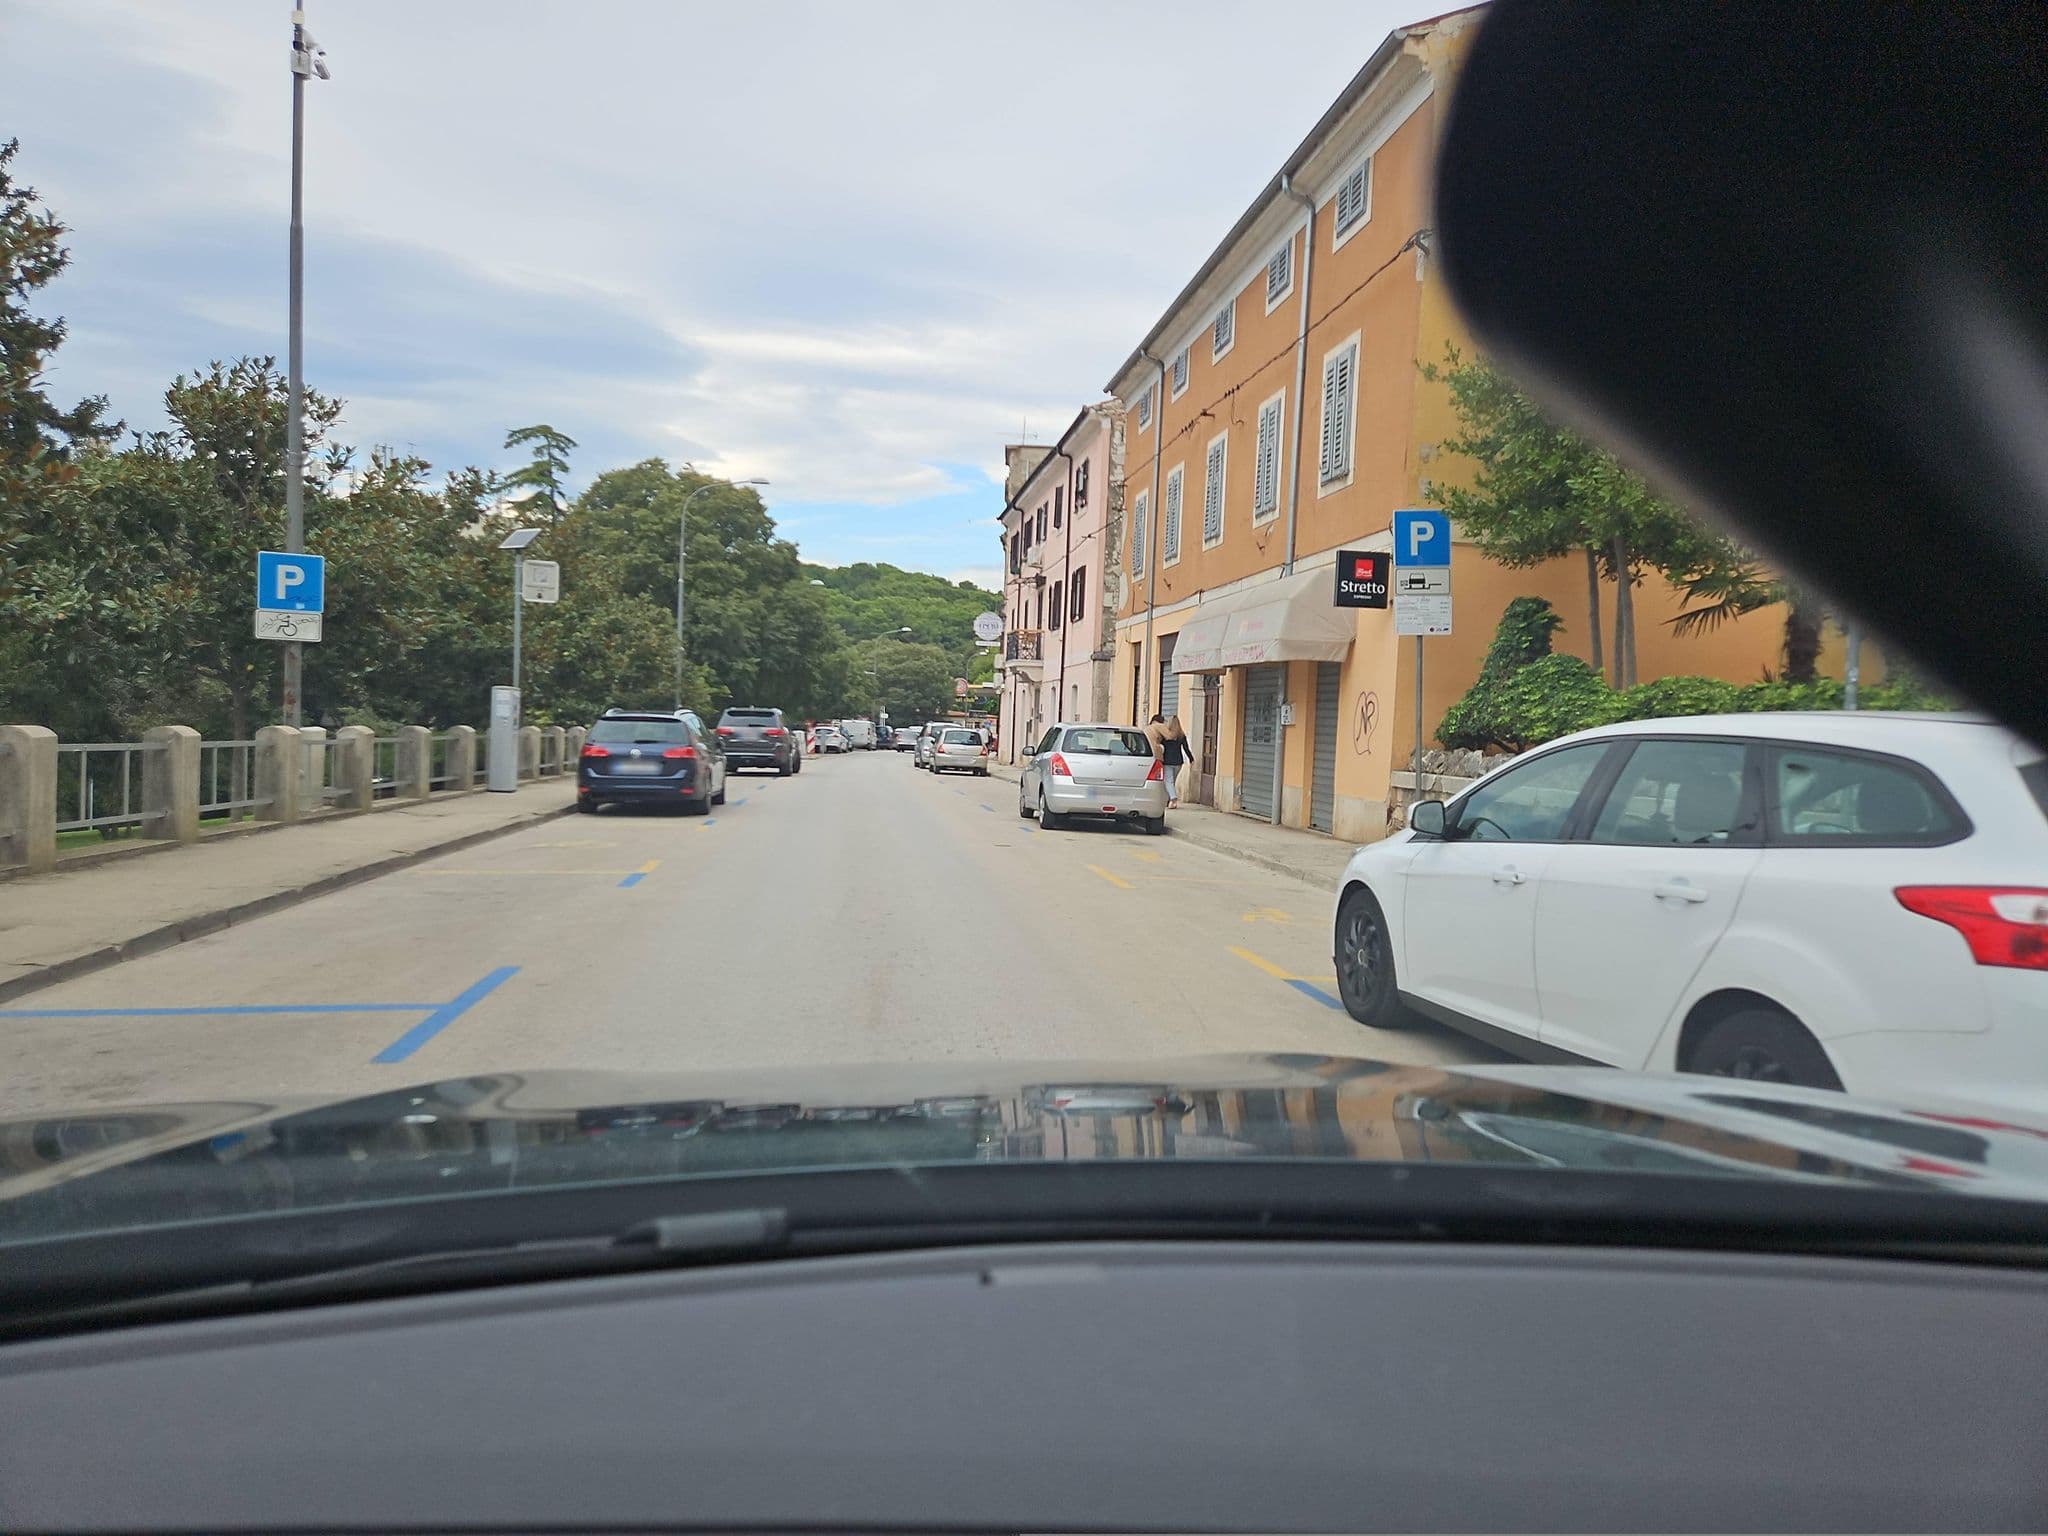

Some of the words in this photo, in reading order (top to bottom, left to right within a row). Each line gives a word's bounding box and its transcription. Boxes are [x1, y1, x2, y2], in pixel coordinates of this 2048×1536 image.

[1410, 520, 1435, 556] P
[277, 565, 305, 599] P
[1340, 580, 1386, 594] Stretto
